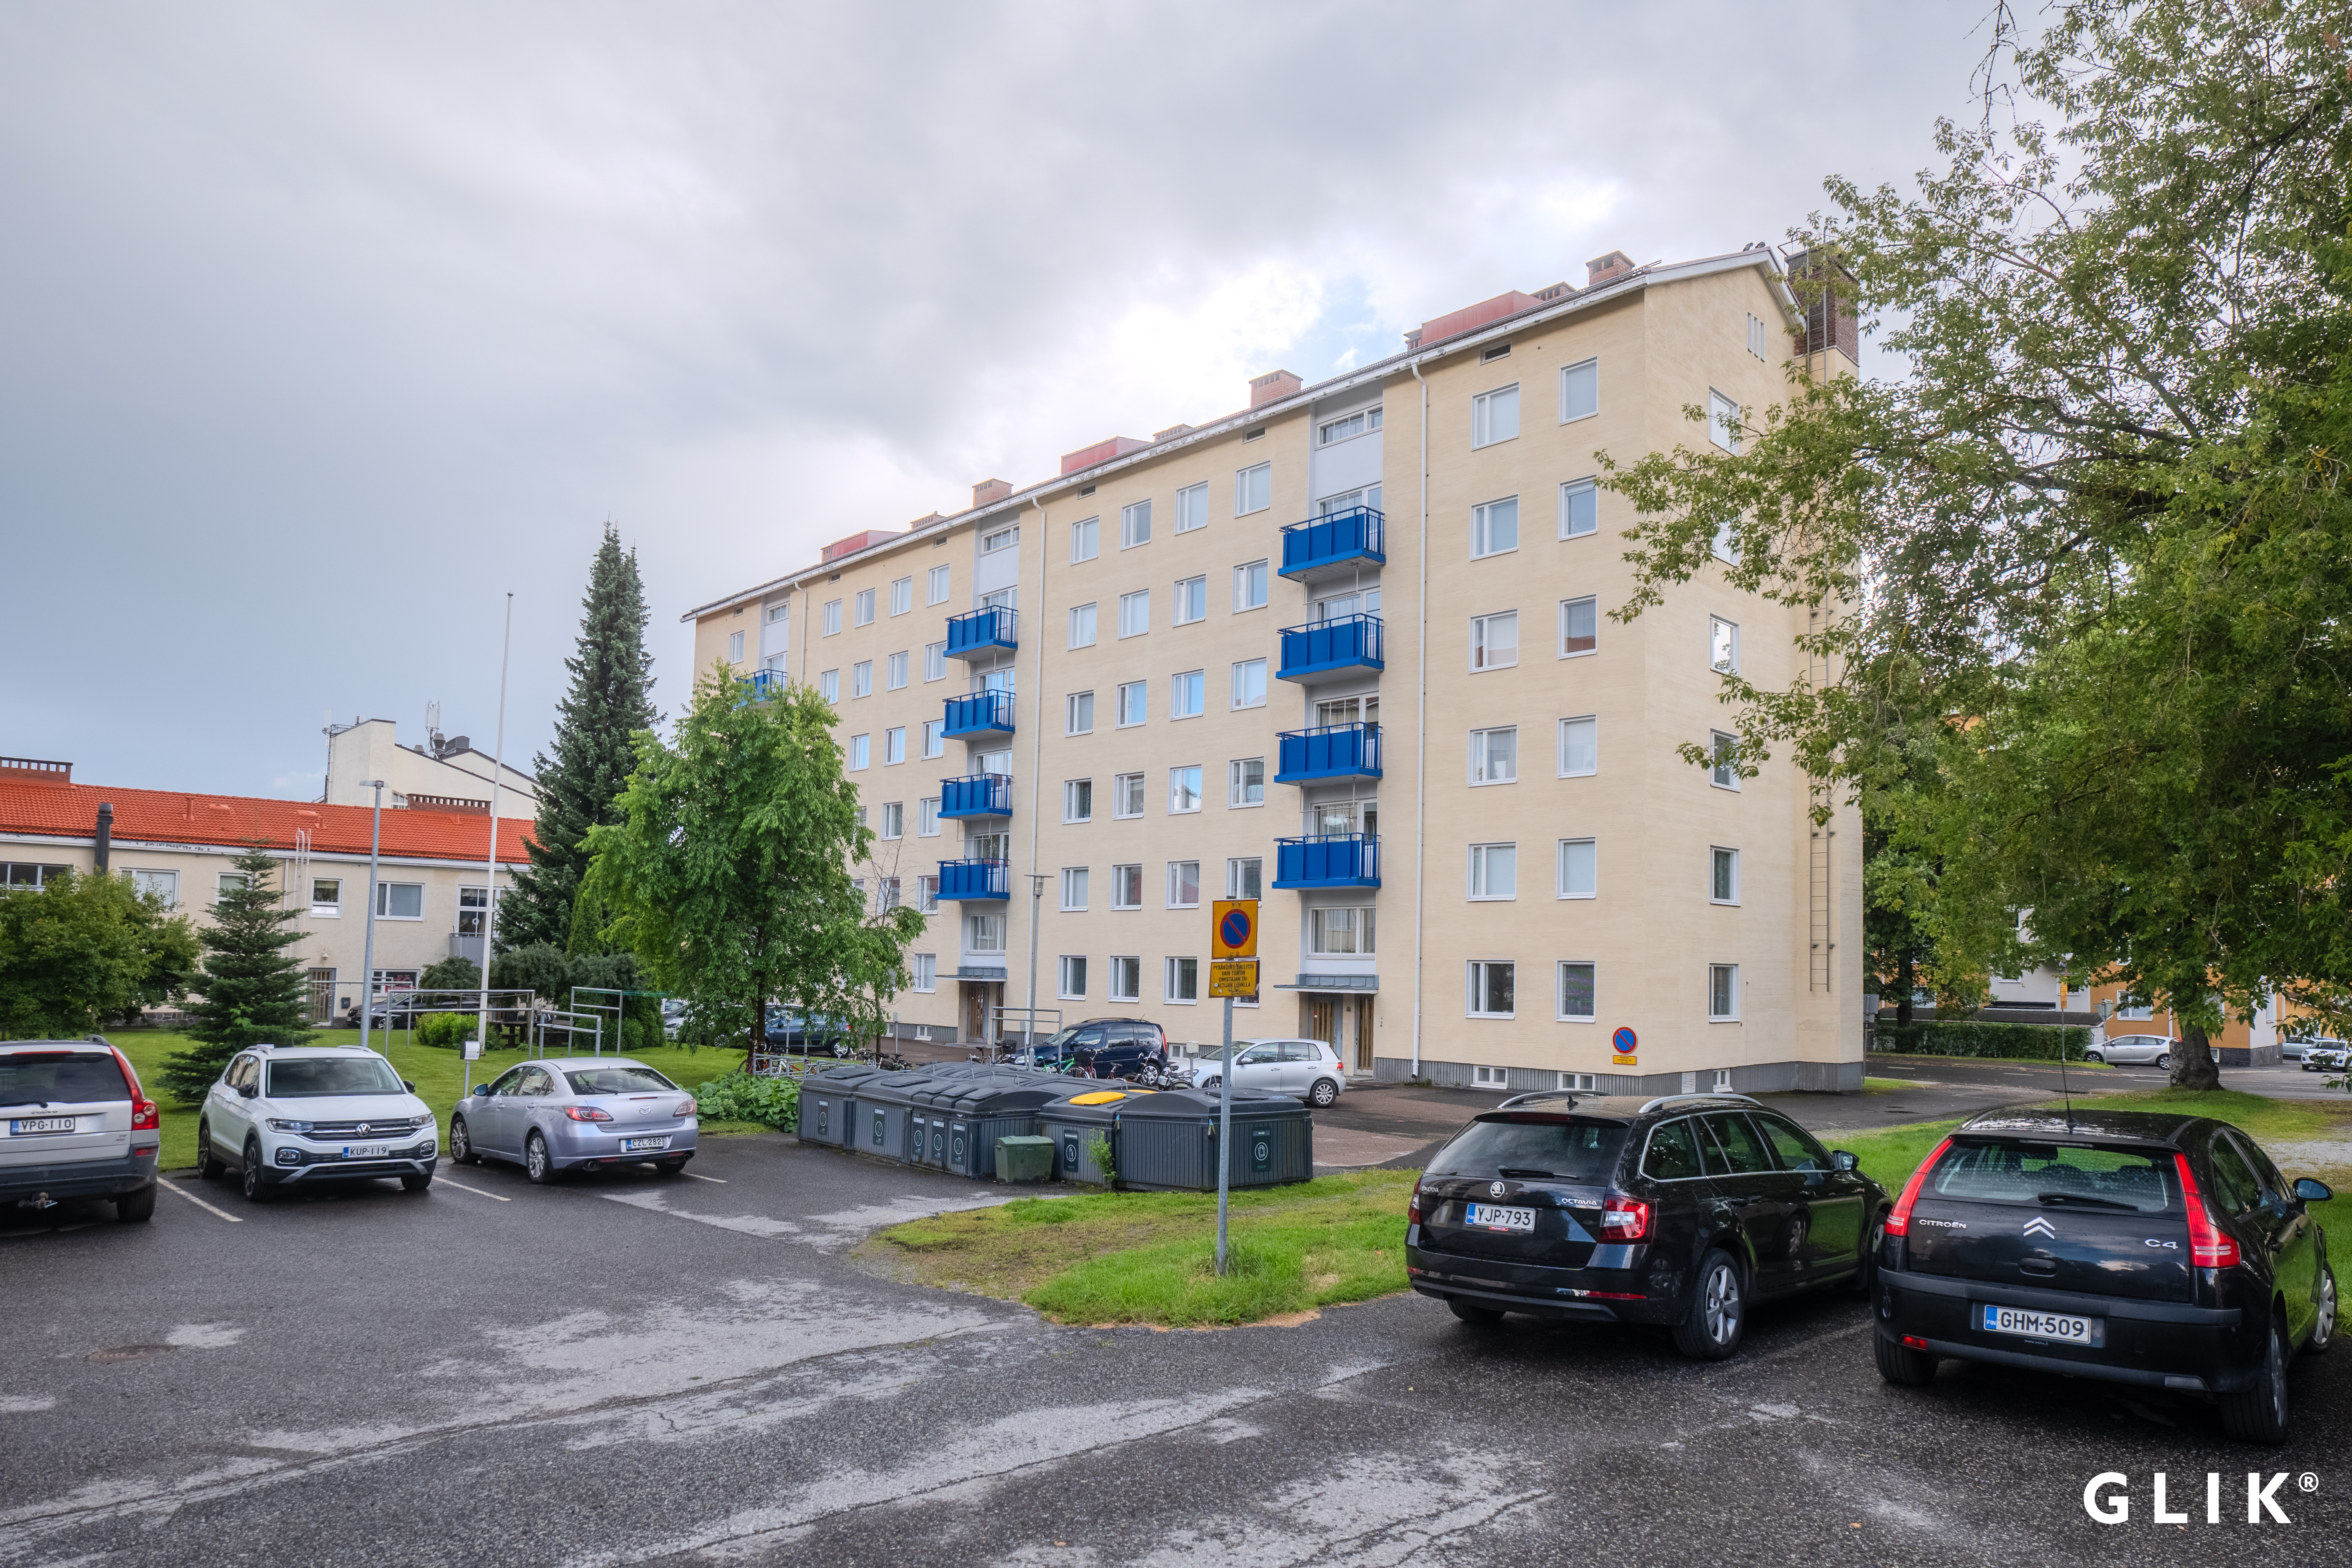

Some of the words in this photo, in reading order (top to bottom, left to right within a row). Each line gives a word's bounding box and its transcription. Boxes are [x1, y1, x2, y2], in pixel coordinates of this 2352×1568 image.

[22, 1119, 71, 1131] VPG-110
[633, 1138, 661, 1147] CZL-282
[350, 1147, 387, 1156] KUP-119
[1478, 1207, 1531, 1225] YJP-793
[1919, 1219, 1967, 1229] CITROËN
[2144, 1239, 2178, 1250] C4
[2000, 1311, 2084, 1337] GHM-509
